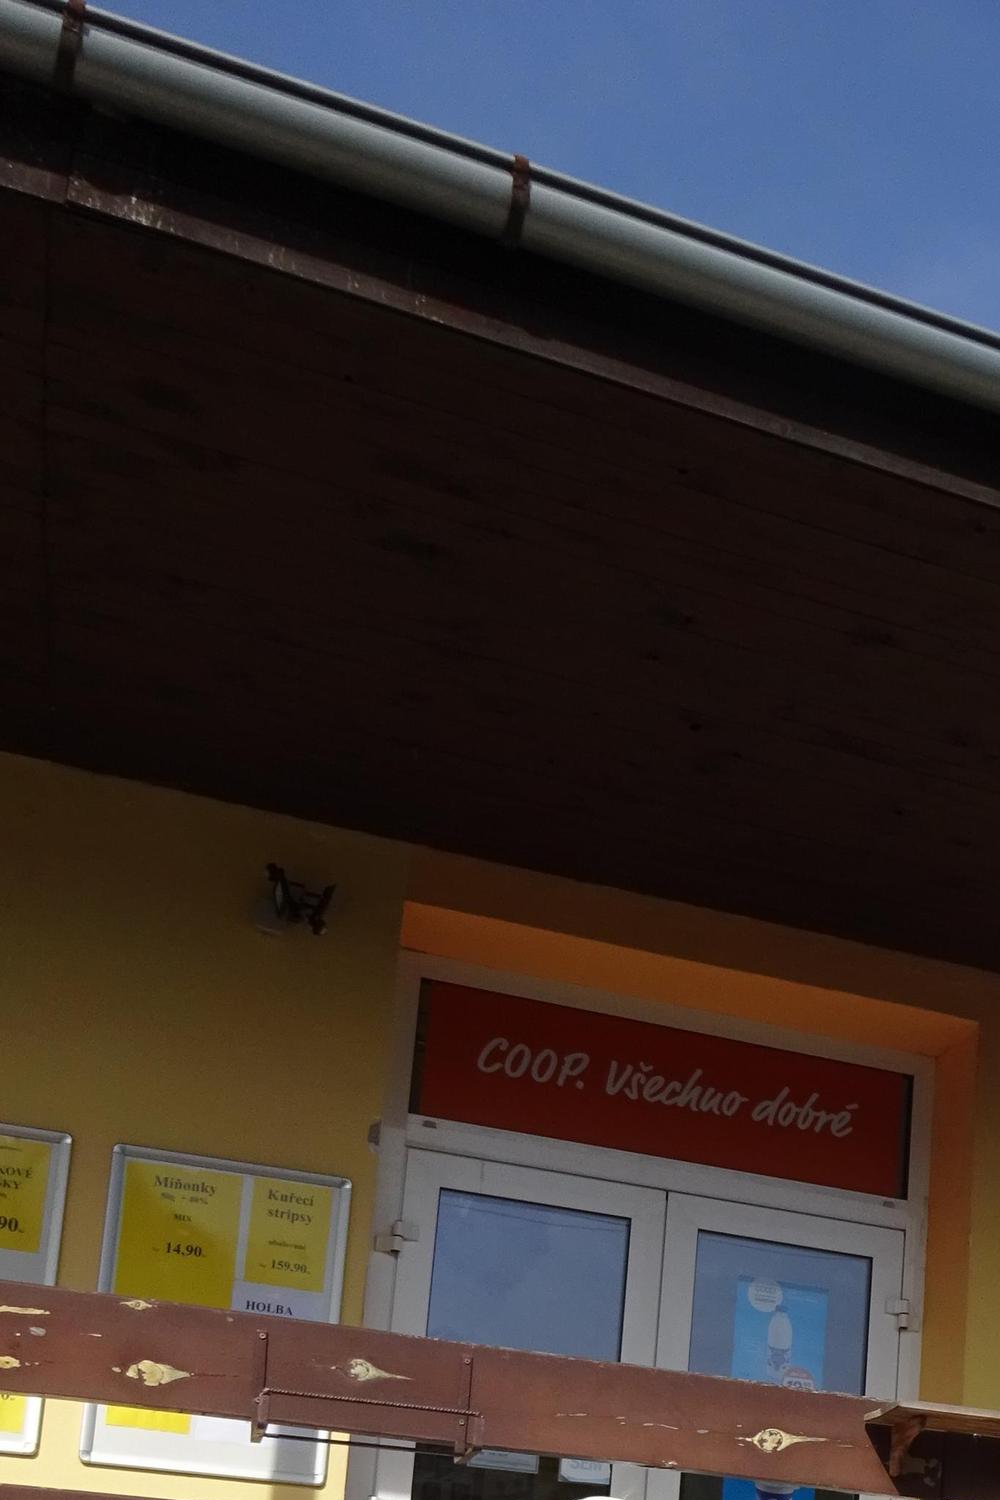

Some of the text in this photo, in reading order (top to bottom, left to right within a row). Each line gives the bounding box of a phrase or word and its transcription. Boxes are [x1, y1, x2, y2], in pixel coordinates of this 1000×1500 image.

[477, 1036, 860, 1138] COOP. Všechno dobré
[267, 1188, 315, 1208] Kuřecí
[267, 1208, 314, 1226] stripsy
[245, 1300, 294, 1317] HOLBA
